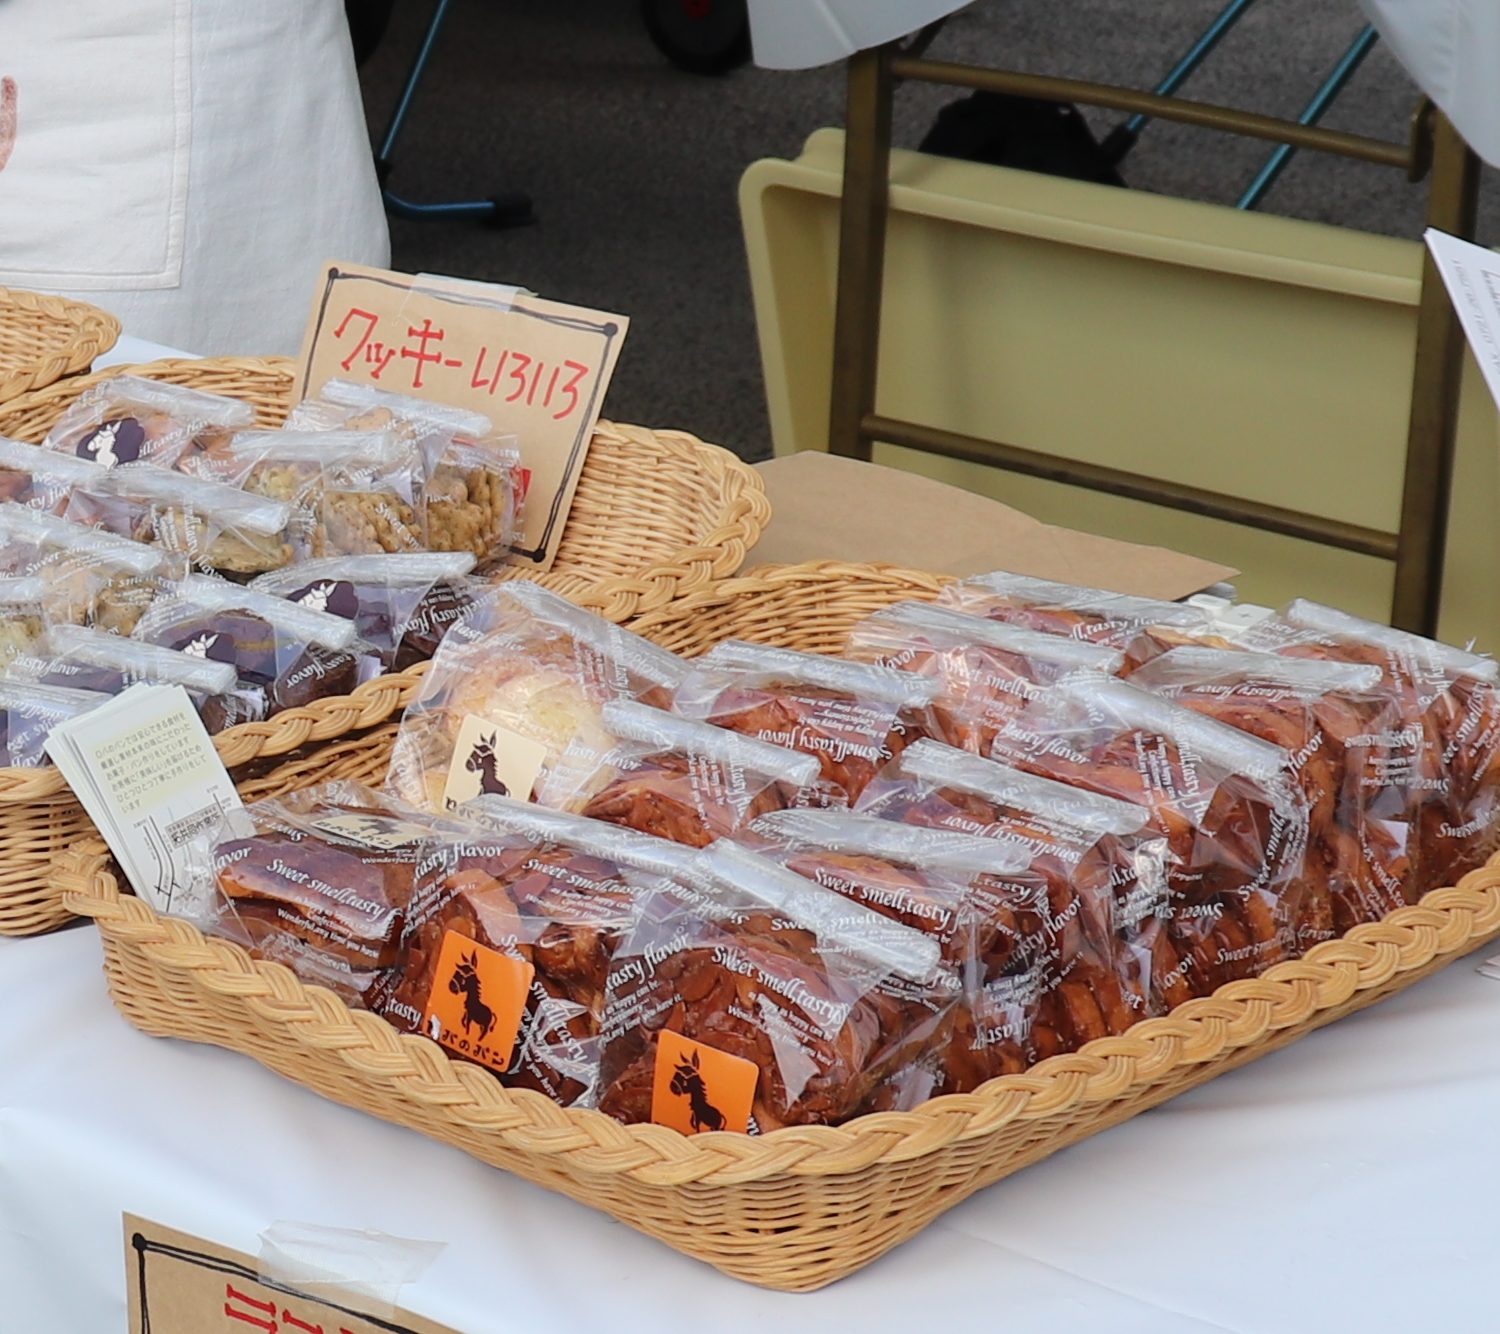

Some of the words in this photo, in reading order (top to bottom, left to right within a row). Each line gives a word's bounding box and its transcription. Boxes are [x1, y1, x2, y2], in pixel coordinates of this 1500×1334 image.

[333, 307, 589, 420] クッキーいろいろ
[266, 857, 310, 885] Sweet
[812, 867, 855, 897] Sweet
[861, 886, 952, 931] smell,tasty
[644, 932, 689, 980] flavor
